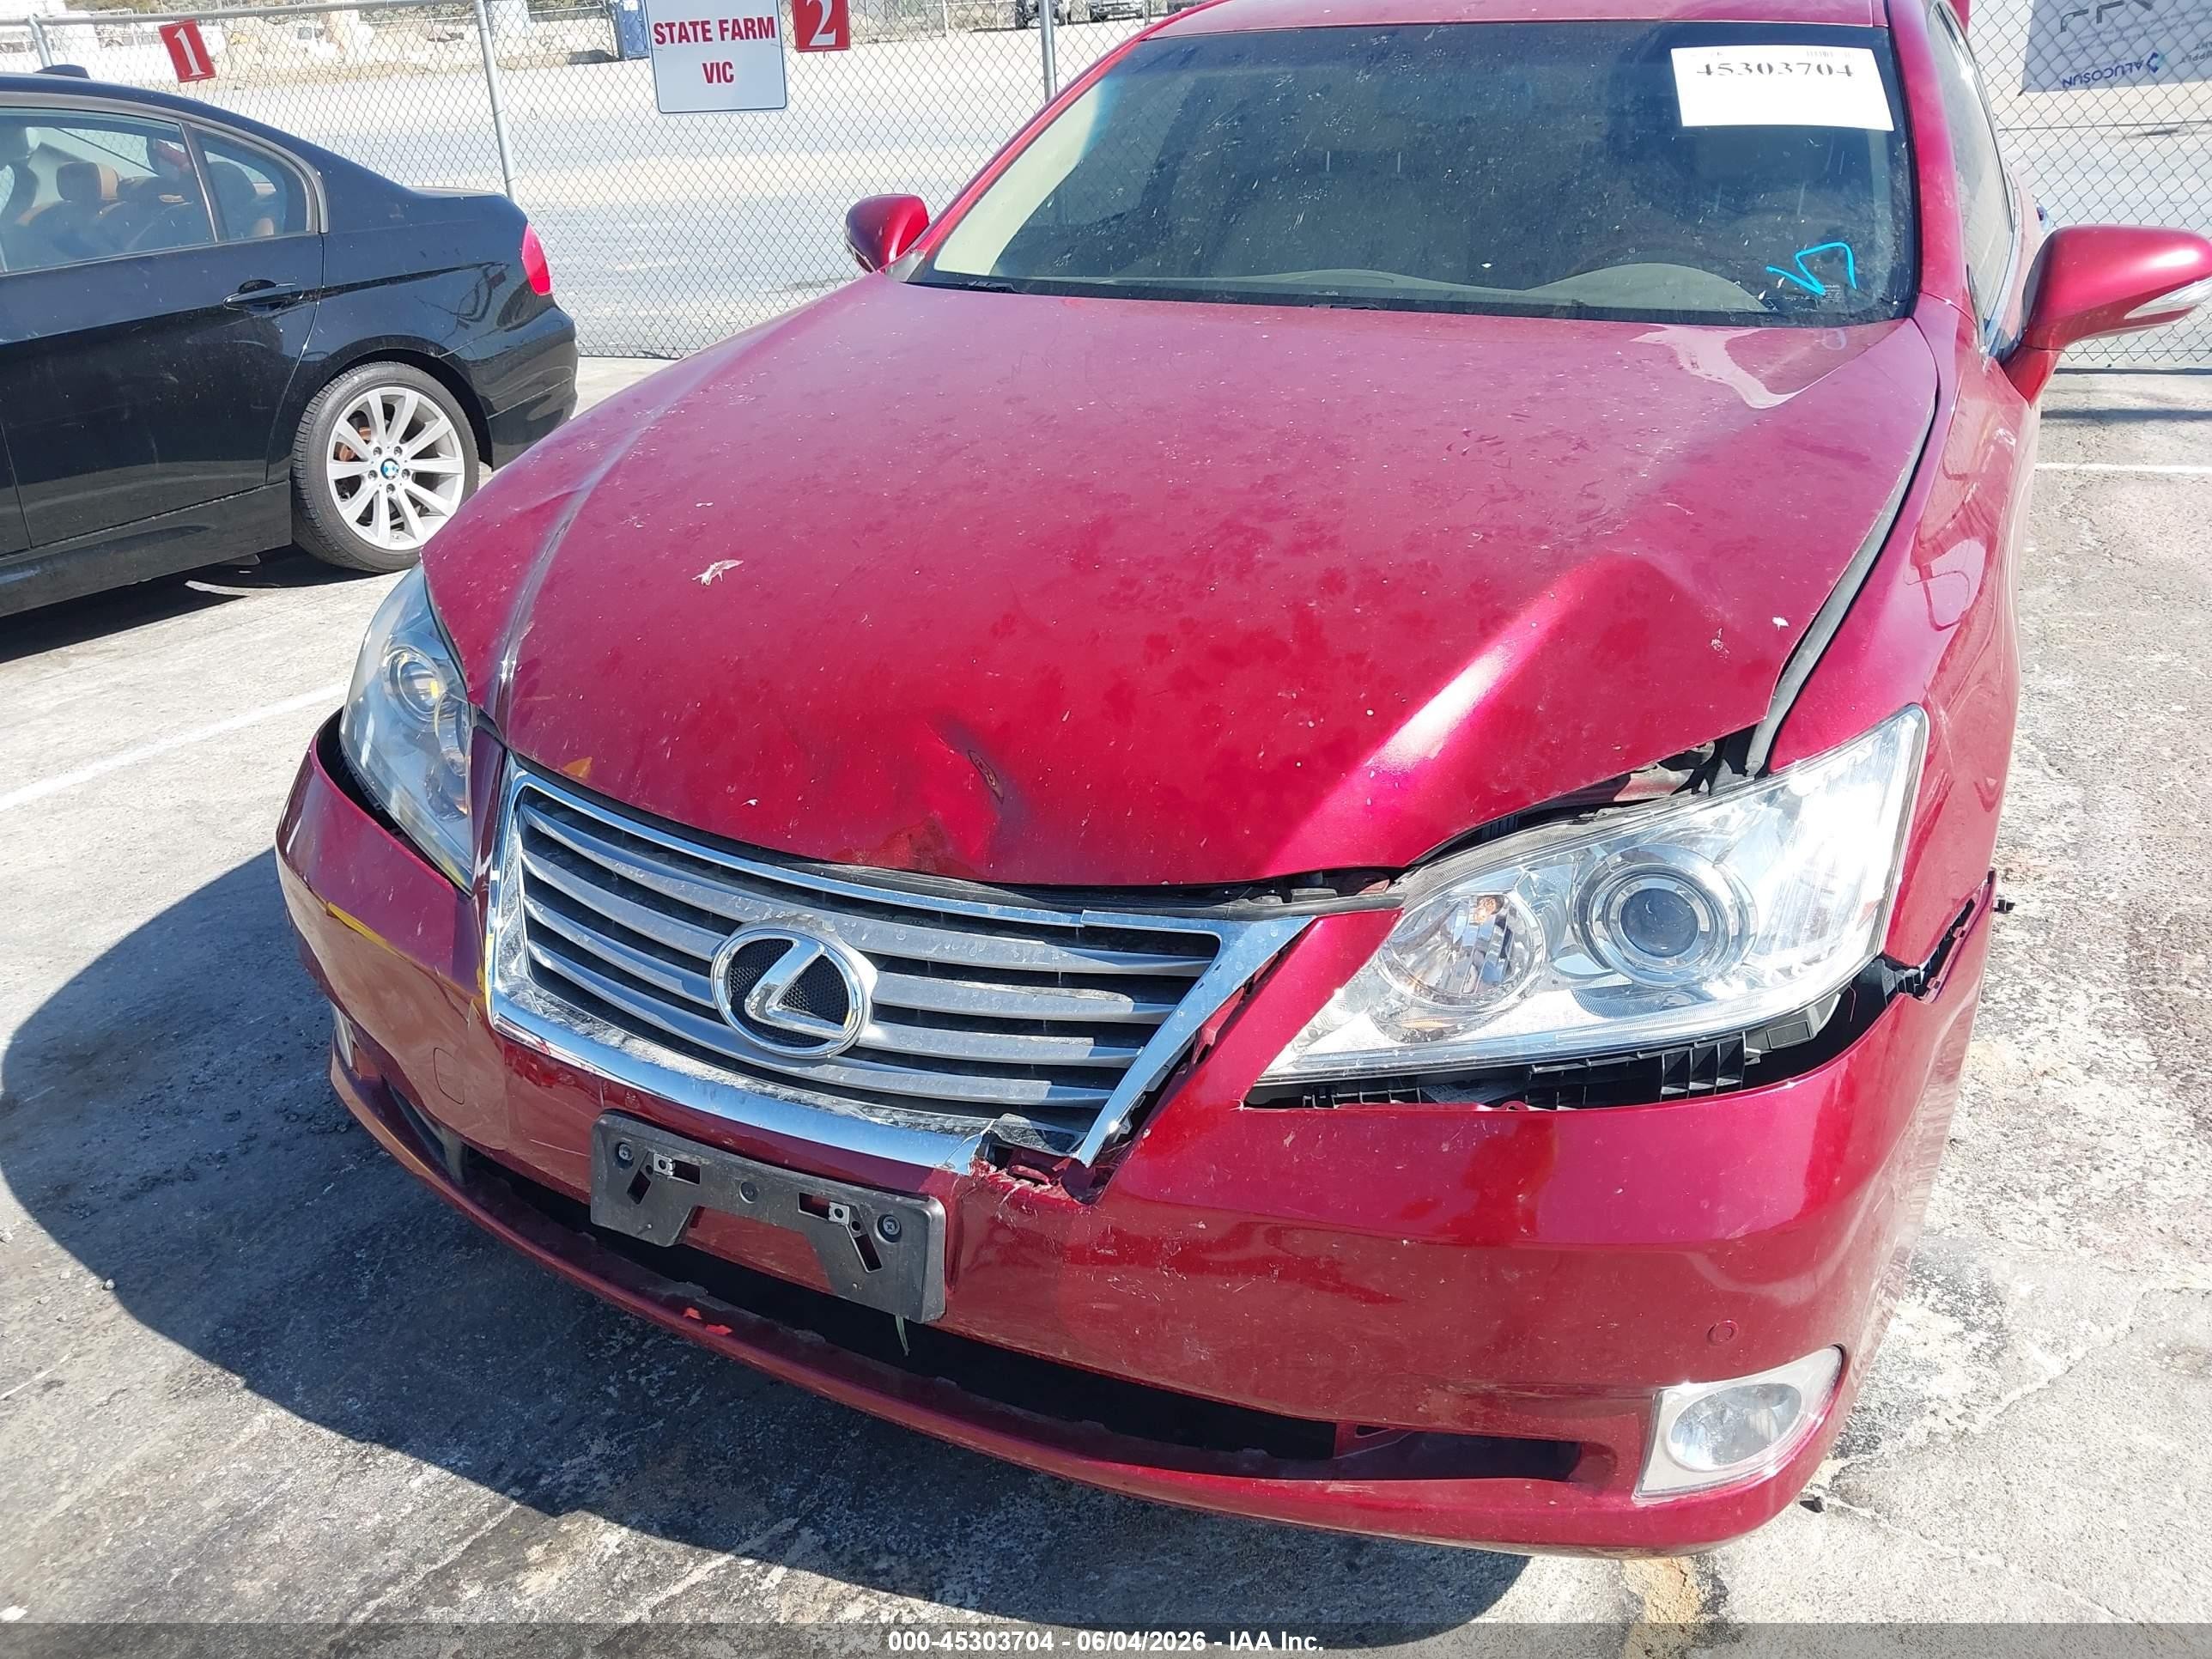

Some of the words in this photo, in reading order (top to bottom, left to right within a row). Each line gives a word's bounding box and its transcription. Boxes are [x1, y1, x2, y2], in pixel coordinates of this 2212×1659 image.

[653, 20, 714, 45] STATE
[718, 16, 776, 41] FARM
[806, 0, 838, 47] 2
[173, 27, 206, 76] 1
[702, 61, 735, 84] VIC
[2062, 60, 2145, 88] ALUCOSUN
